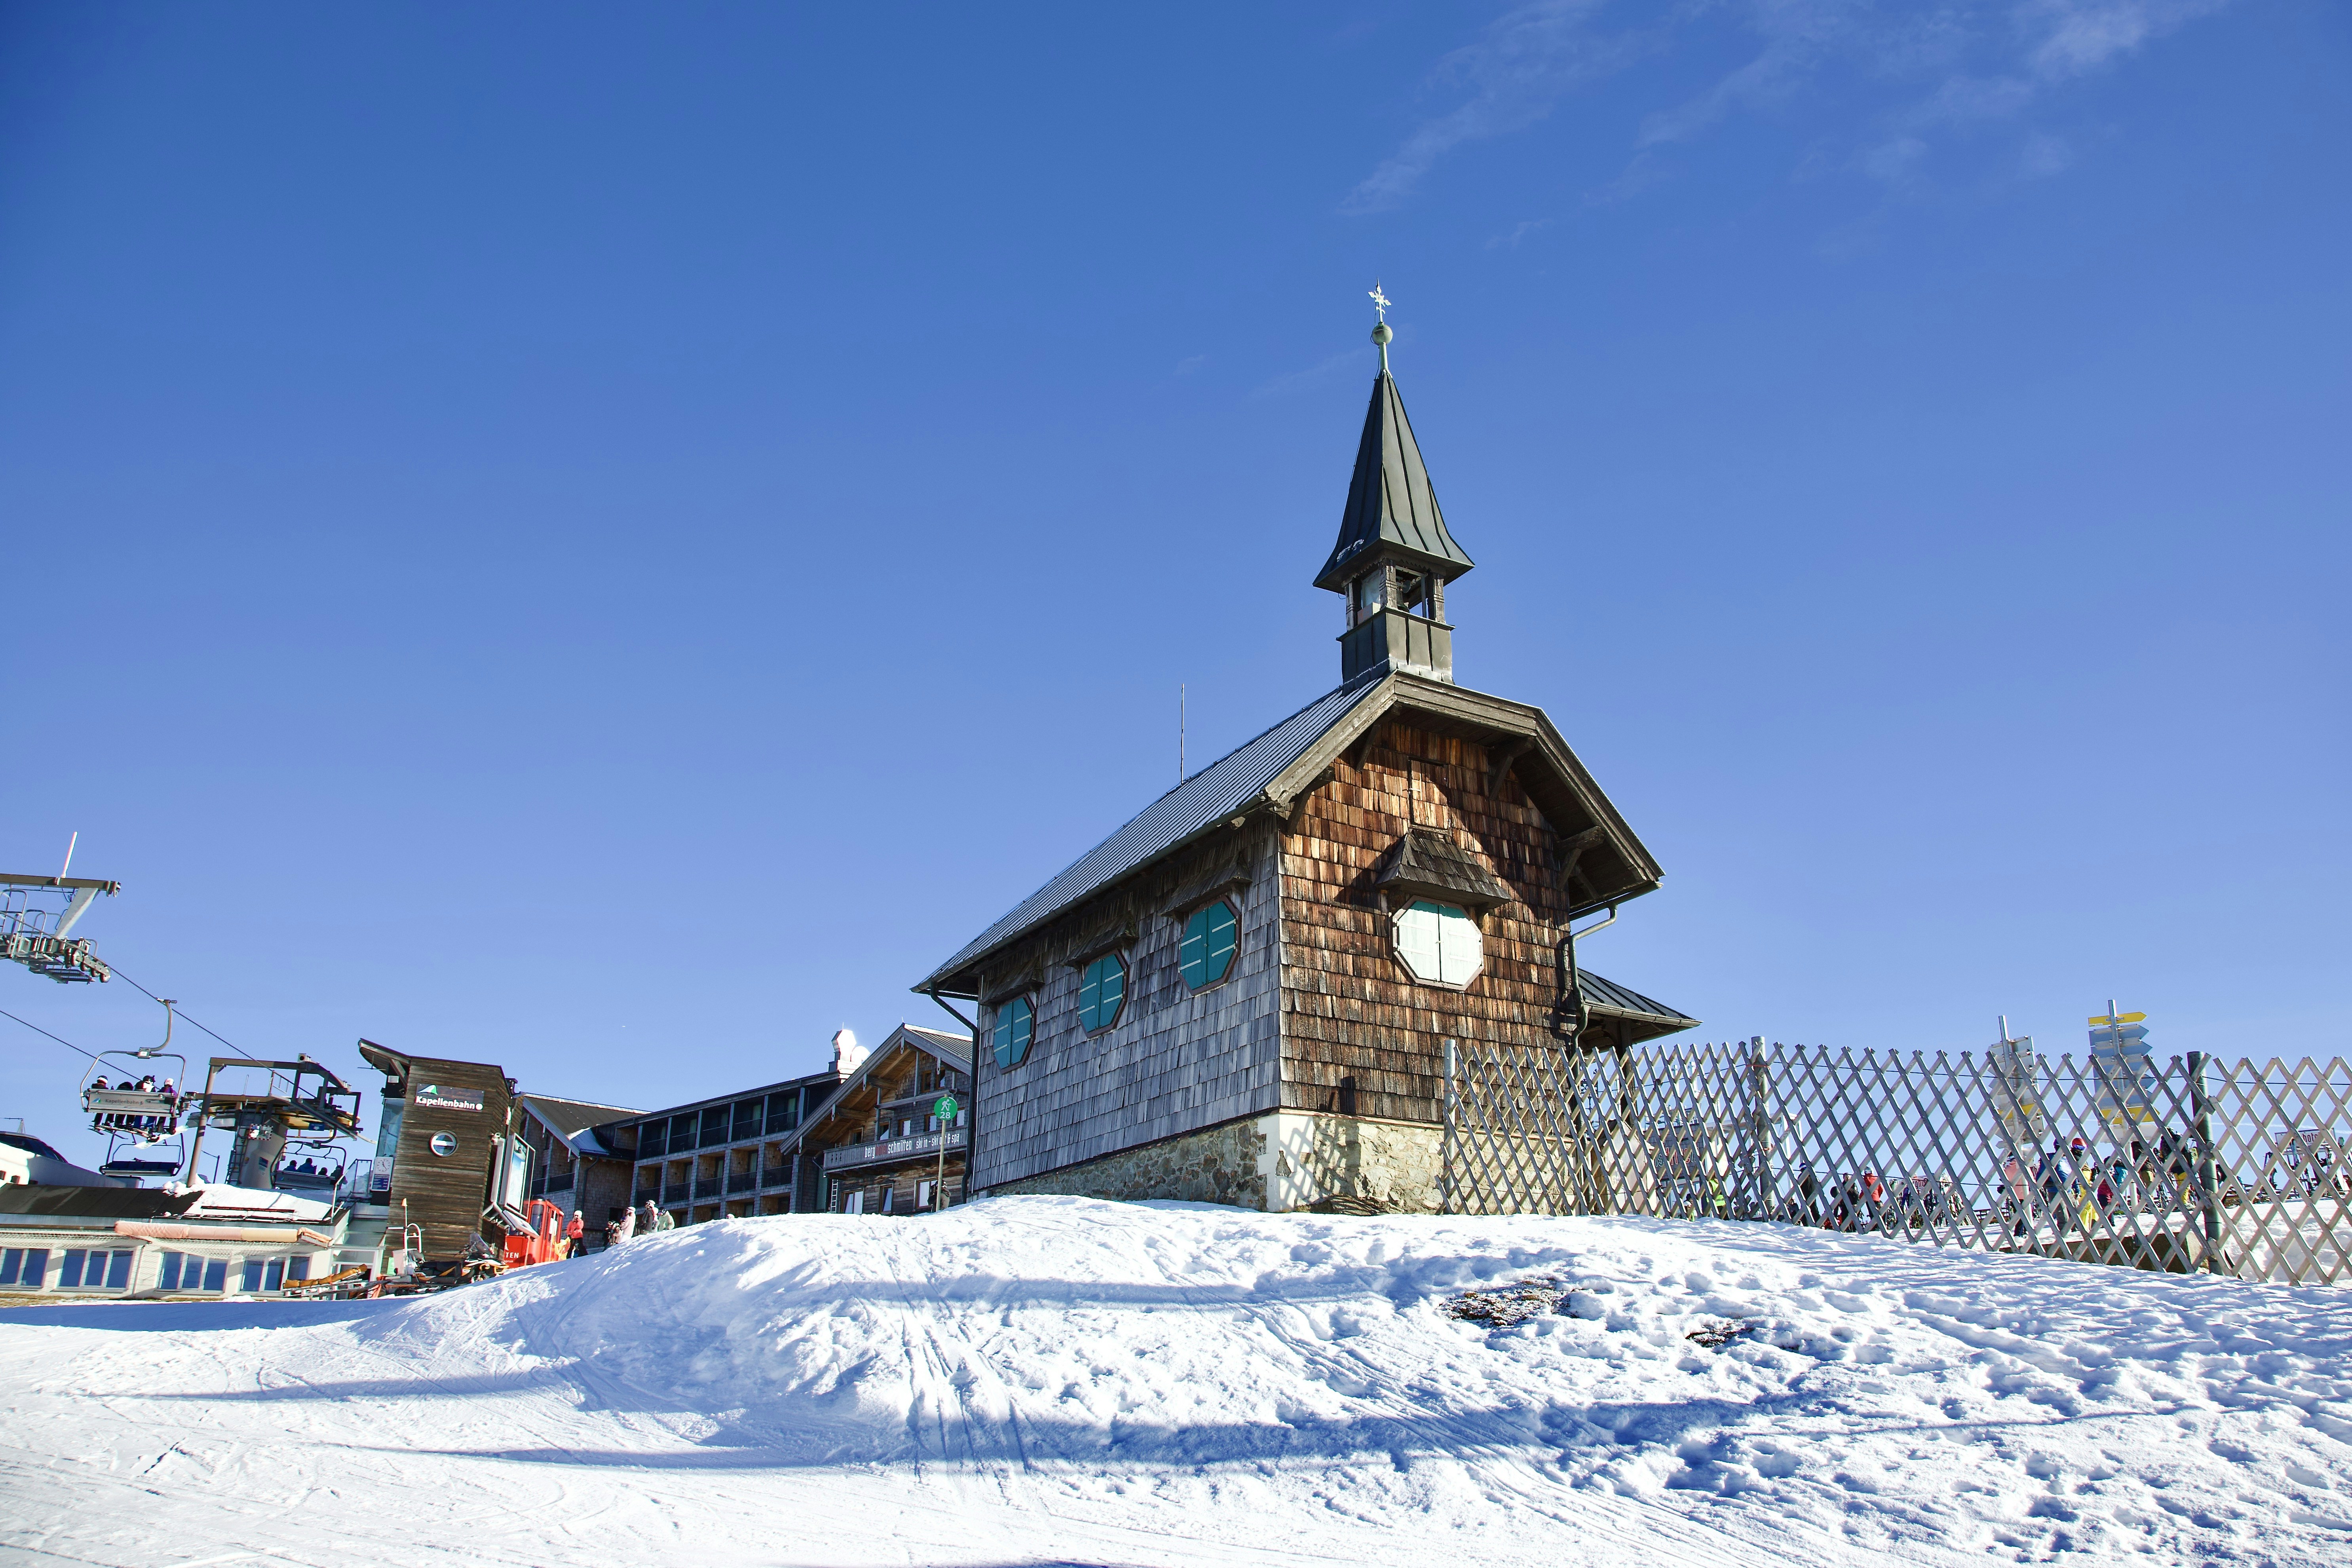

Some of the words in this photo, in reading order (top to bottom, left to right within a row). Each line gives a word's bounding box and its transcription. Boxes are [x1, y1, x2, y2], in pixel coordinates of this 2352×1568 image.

[415, 1096, 475, 1110] Kapellenbahn
[888, 1139, 912, 1154] schmitten
[924, 1138, 928, 1148] in
[947, 1133, 951, 1144] &
[951, 1133, 960, 1144] spa
